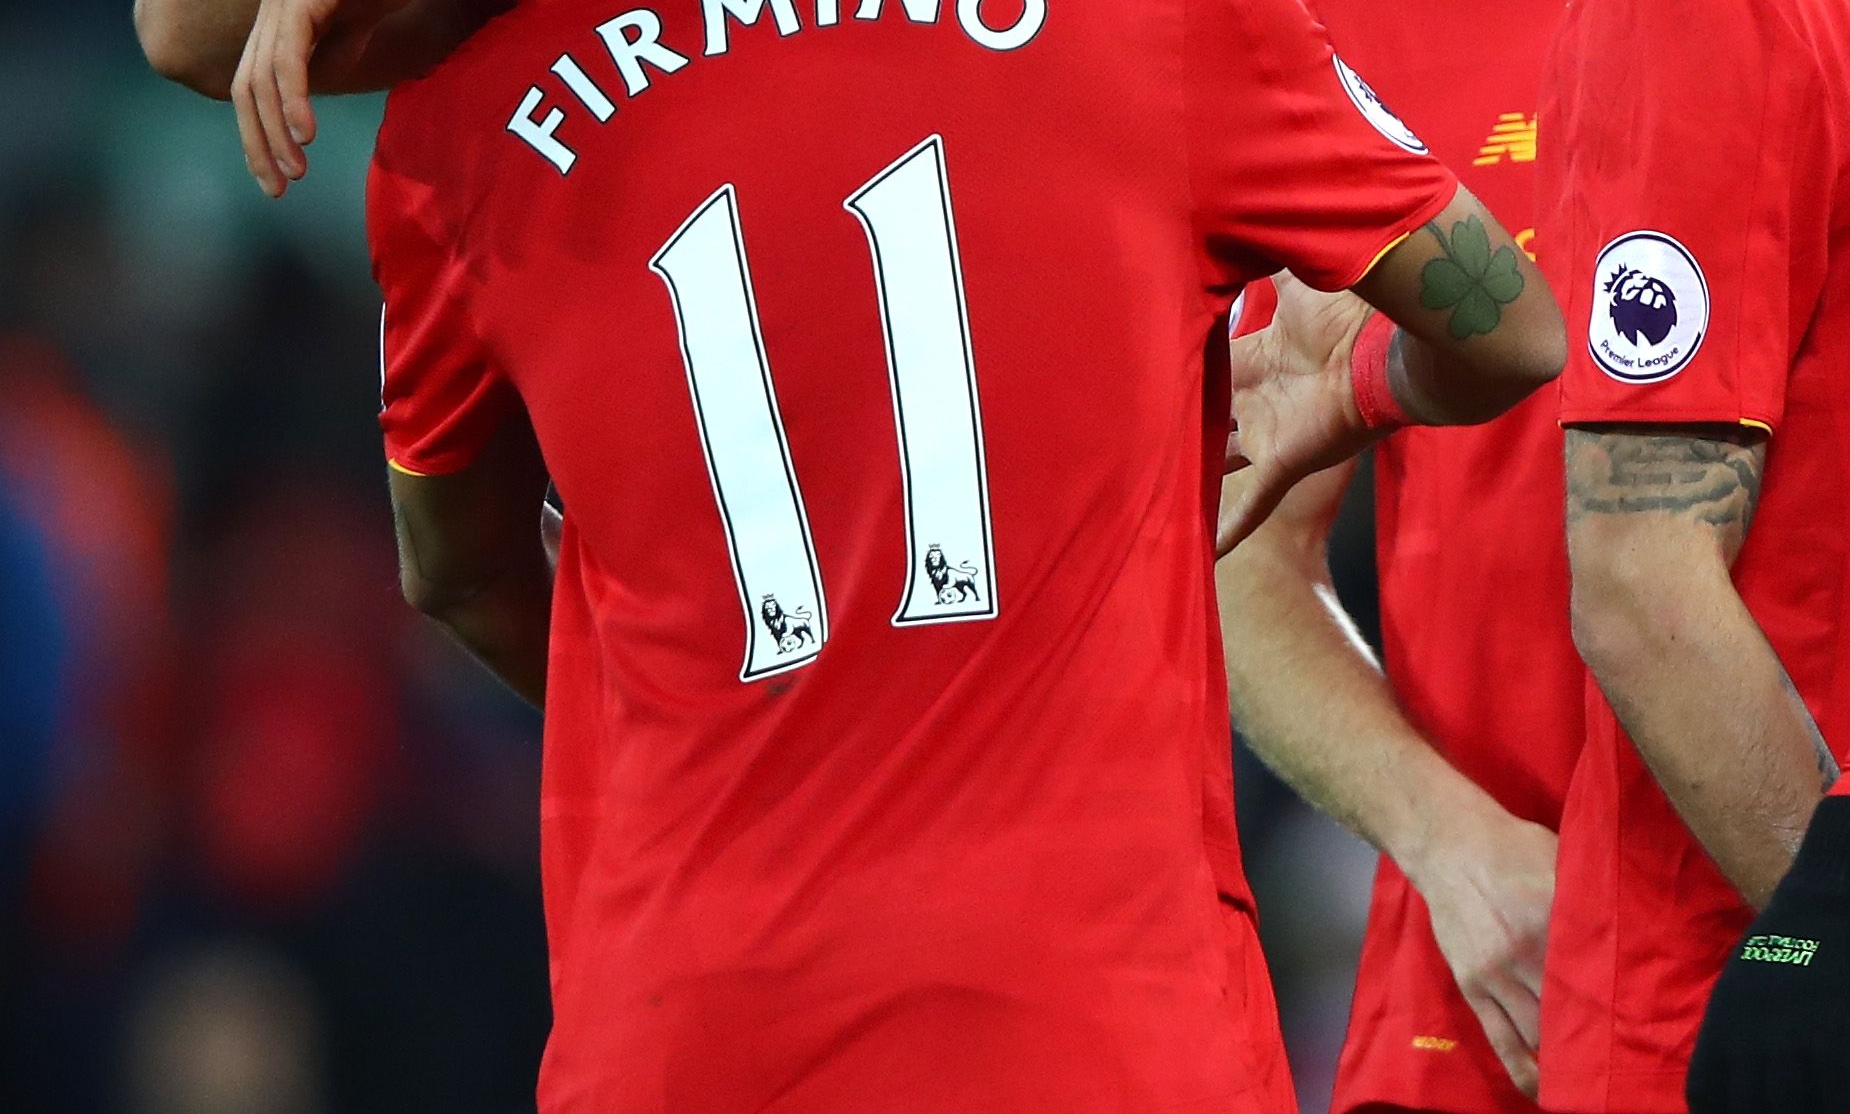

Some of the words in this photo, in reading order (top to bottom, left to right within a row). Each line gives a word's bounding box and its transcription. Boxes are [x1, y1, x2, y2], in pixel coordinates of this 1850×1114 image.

[647, 132, 999, 684] 11
[1600, 339, 1634, 368] Premier
[1638, 346, 1679, 368] League
